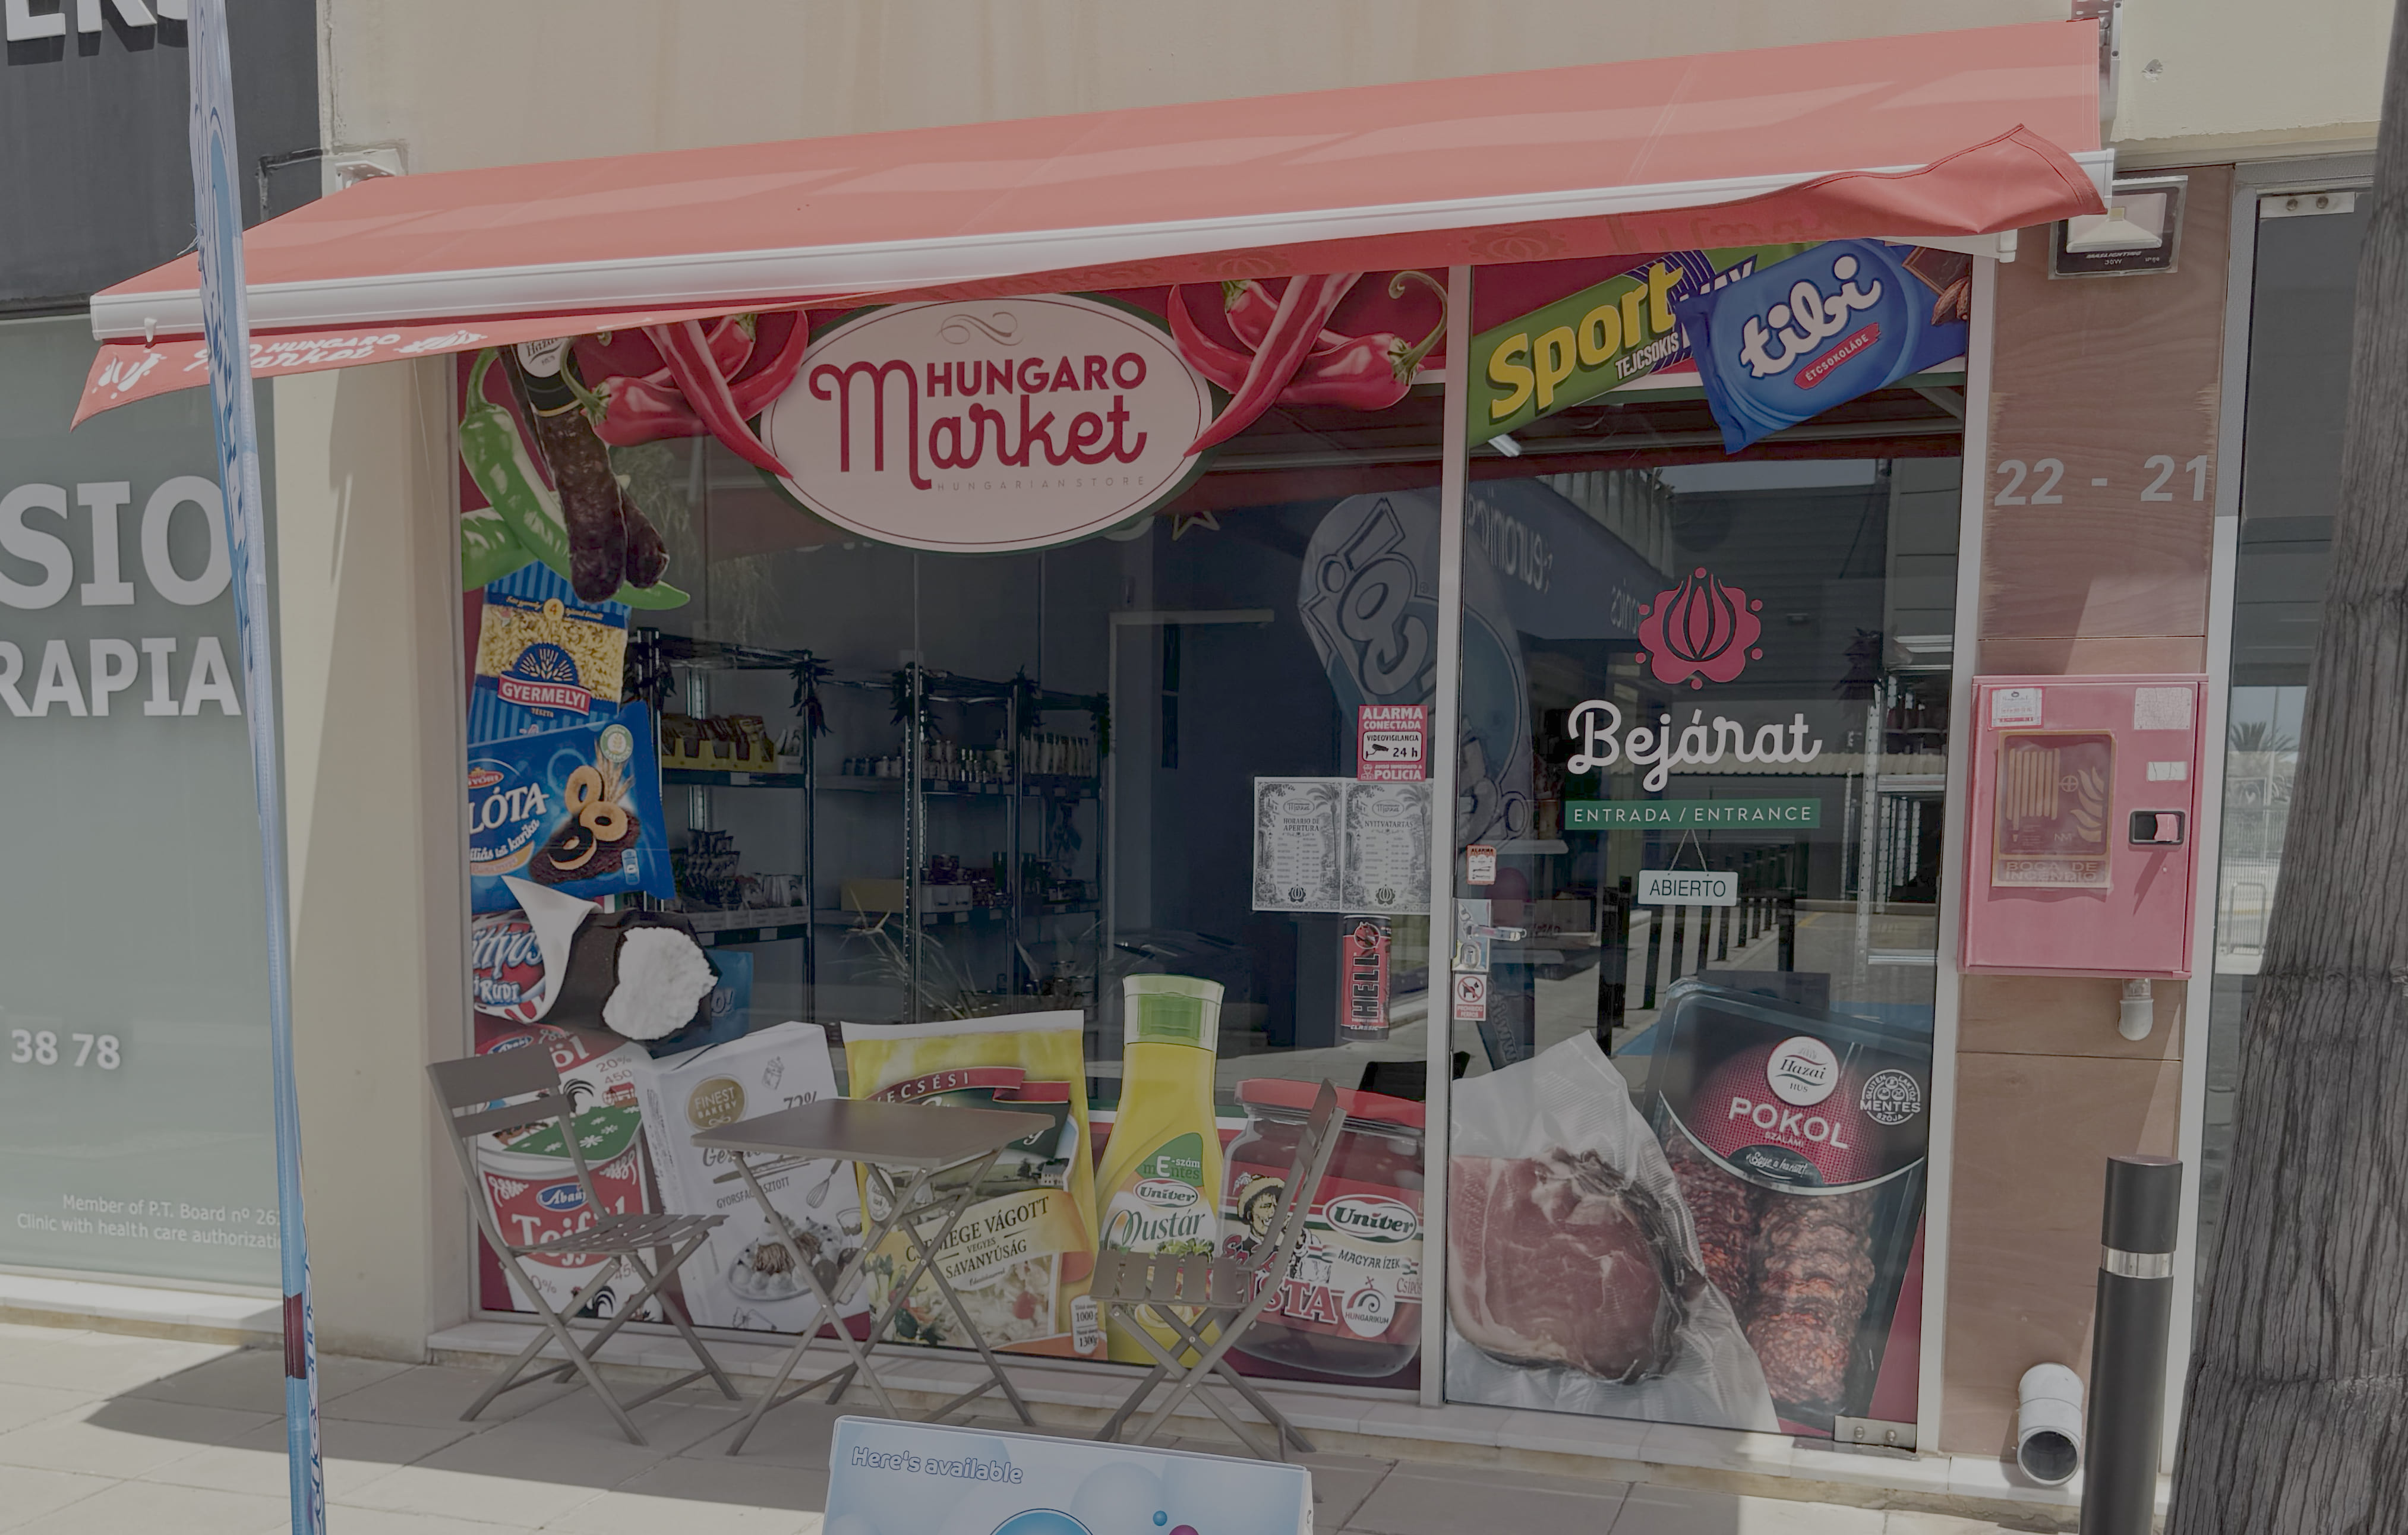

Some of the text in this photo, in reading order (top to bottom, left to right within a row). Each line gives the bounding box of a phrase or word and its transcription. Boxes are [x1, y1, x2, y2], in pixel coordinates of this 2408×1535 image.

[1740, 255, 1885, 377] tibi
[267, 333, 401, 355] HUNGARO
[1489, 260, 1683, 419] Sport
[1804, 333, 1870, 382] ÉTCSOKOLÁDE
[927, 352, 1147, 398] HUNGARO
[809, 359, 1147, 491] Market
[938, 475, 1145, 492] HUNGARIAN STORE
[1994, 458, 2065, 507] 22
[2140, 454, 2208, 502] 21
[550, 604, 557, 615] 4
[501, 681, 586, 709] GYERMELYI
[1362, 708, 1423, 719] ALARMA
[1364, 721, 1421, 729] CONECTADA
[1393, 747, 1418, 757] 24 h
[1567, 699, 1823, 792] Bejárat
[1374, 770, 1422, 780] POLICIA
[1574, 806, 1811, 823] ENTRADA / ENTRANCE
[507, 819, 539, 851] karika
[2006, 861, 2098, 871] BOCA DE
[1649, 880, 1726, 896] ABIERTO
[1352, 953, 1380, 1018] HELL
[11, 1029, 121, 1069] 38 78
[596, 1057, 633, 1073] 20%
[605, 1069, 633, 1084] 450
[1780, 1059, 1827, 1080] Hazai
[695, 1086, 735, 1110] FINEST
[878, 1071, 968, 1103] ECSÉSI
[698, 1101, 737, 1119] BAKERY
[1860, 1100, 1921, 1113] MENTES
[1728, 1097, 1849, 1149] POKOL
[1140, 1187, 1195, 1204] Univer
[63, 1194, 123, 1214] Member
[129, 1200, 144, 1215] of
[149, 1201, 174, 1218] P.T.
[180, 1204, 225, 1222] Board
[984, 1196, 1049, 1235] VÁGOTT
[1334, 1206, 1413, 1234] Univer
[17, 1214, 58, 1231] Clinic
[61, 1217, 93, 1234] with
[97, 1220, 149, 1239] health
[153, 1227, 187, 1242] care
[1106, 1208, 1205, 1250] Mustár
[966, 1237, 996, 1254] VEGYES
[946, 1239, 1027, 1279] SAVANYÚSÁG
[1338, 1249, 1400, 1269] MAGYAR ÍZEK
[1077, 1311, 1093, 1322] 1000
[1345, 1311, 1389, 1325] HUNGARIKUM
[851, 1446, 1023, 1485] Here's available
